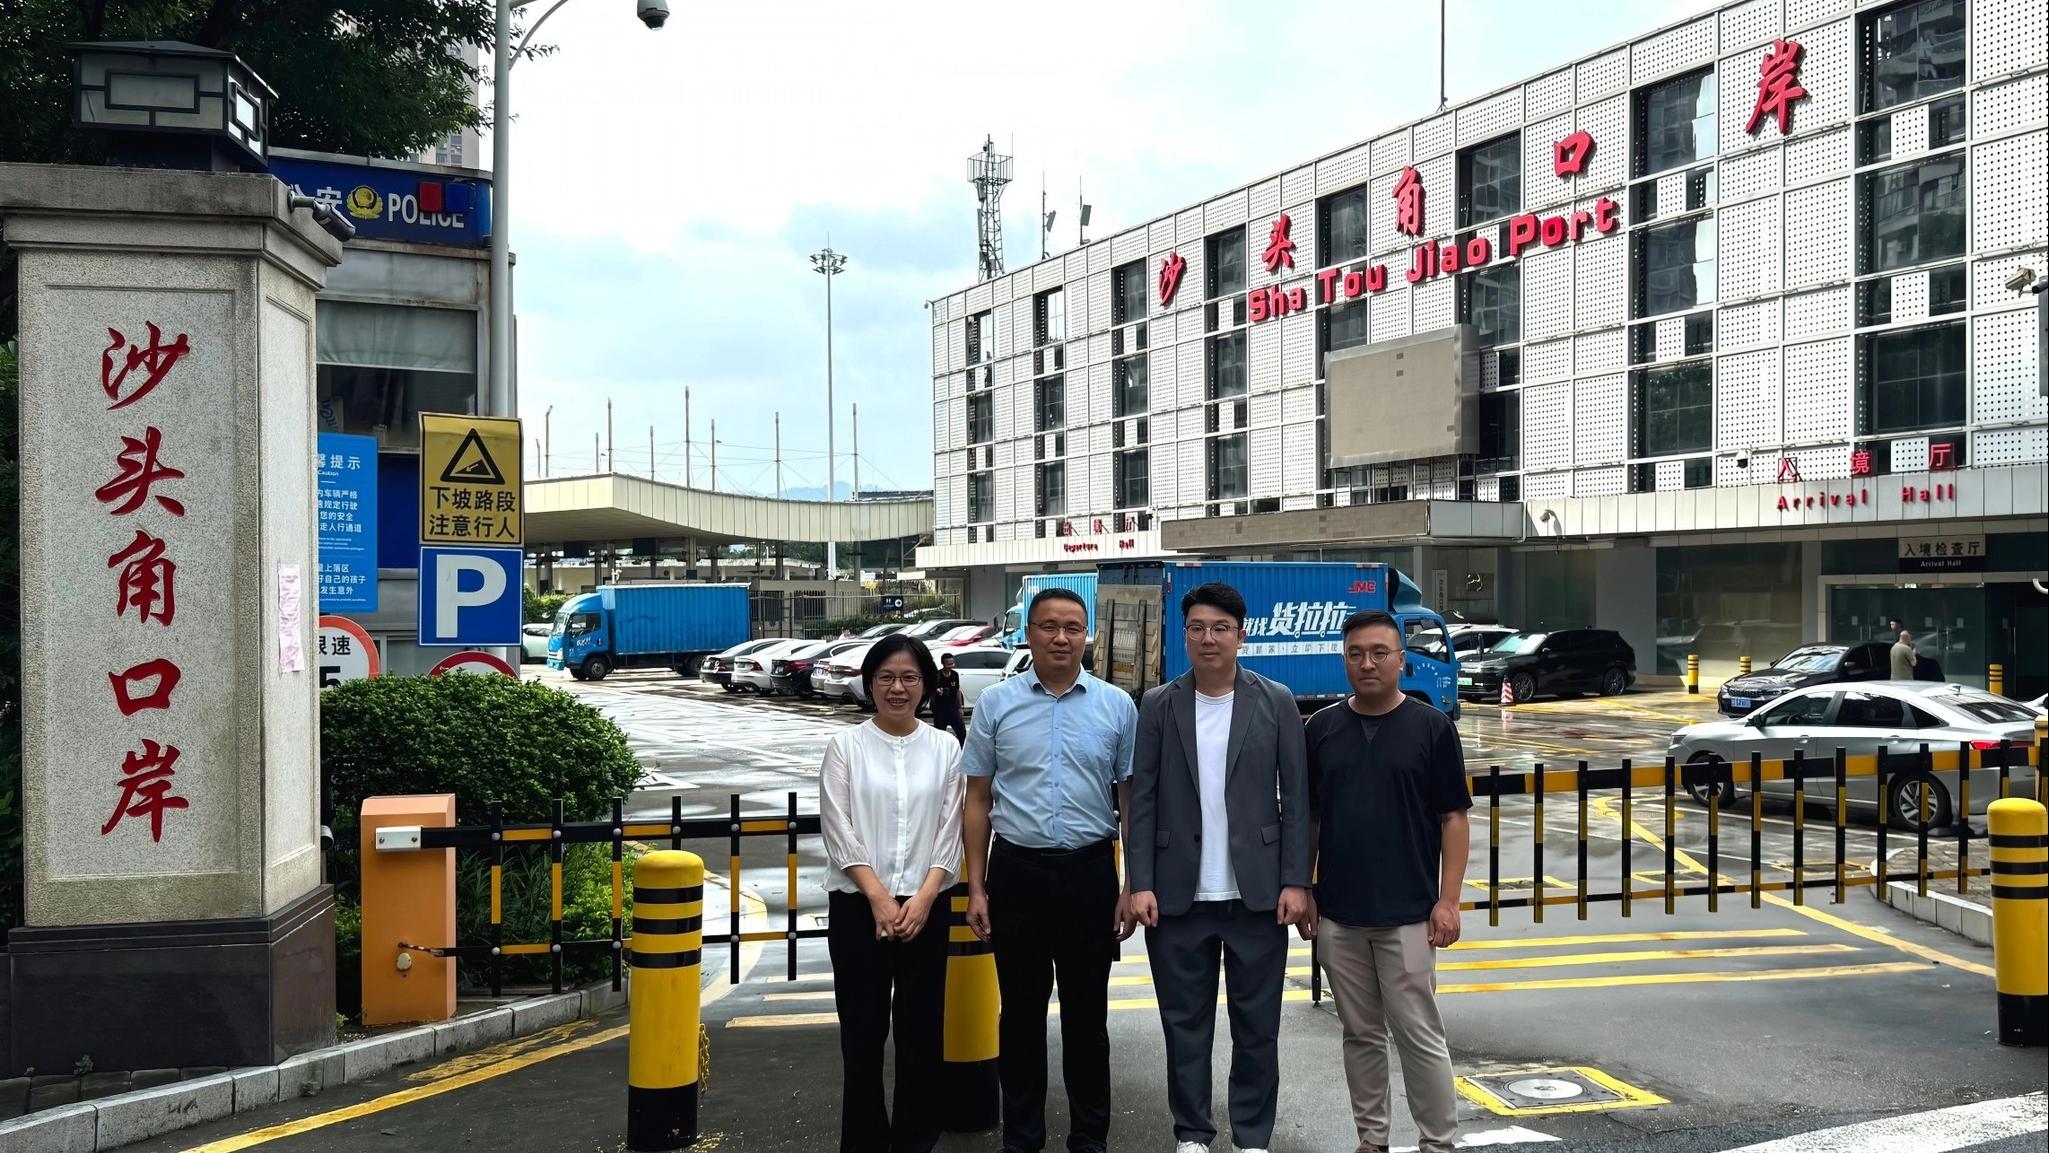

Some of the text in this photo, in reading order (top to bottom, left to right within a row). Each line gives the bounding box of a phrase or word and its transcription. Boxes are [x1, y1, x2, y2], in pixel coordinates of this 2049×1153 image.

[1249, 196, 1620, 323] Sha Tou Jiao Port
[1778, 443, 1953, 482] 入境厅
[429, 486, 516, 512] 下坡路段
[1777, 483, 1955, 512] Arrival Hall
[320, 511, 354, 522] 您的安全
[320, 522, 362, 533] 走人行通道
[429, 515, 515, 539] 注意行人
[1904, 541, 1980, 557] 入境检查厅
[1920, 560, 1945, 568] Arrival
[95, 320, 190, 843] 沙头角口岸
[320, 585, 354, 595] 发生意外
[436, 554, 507, 638] P
